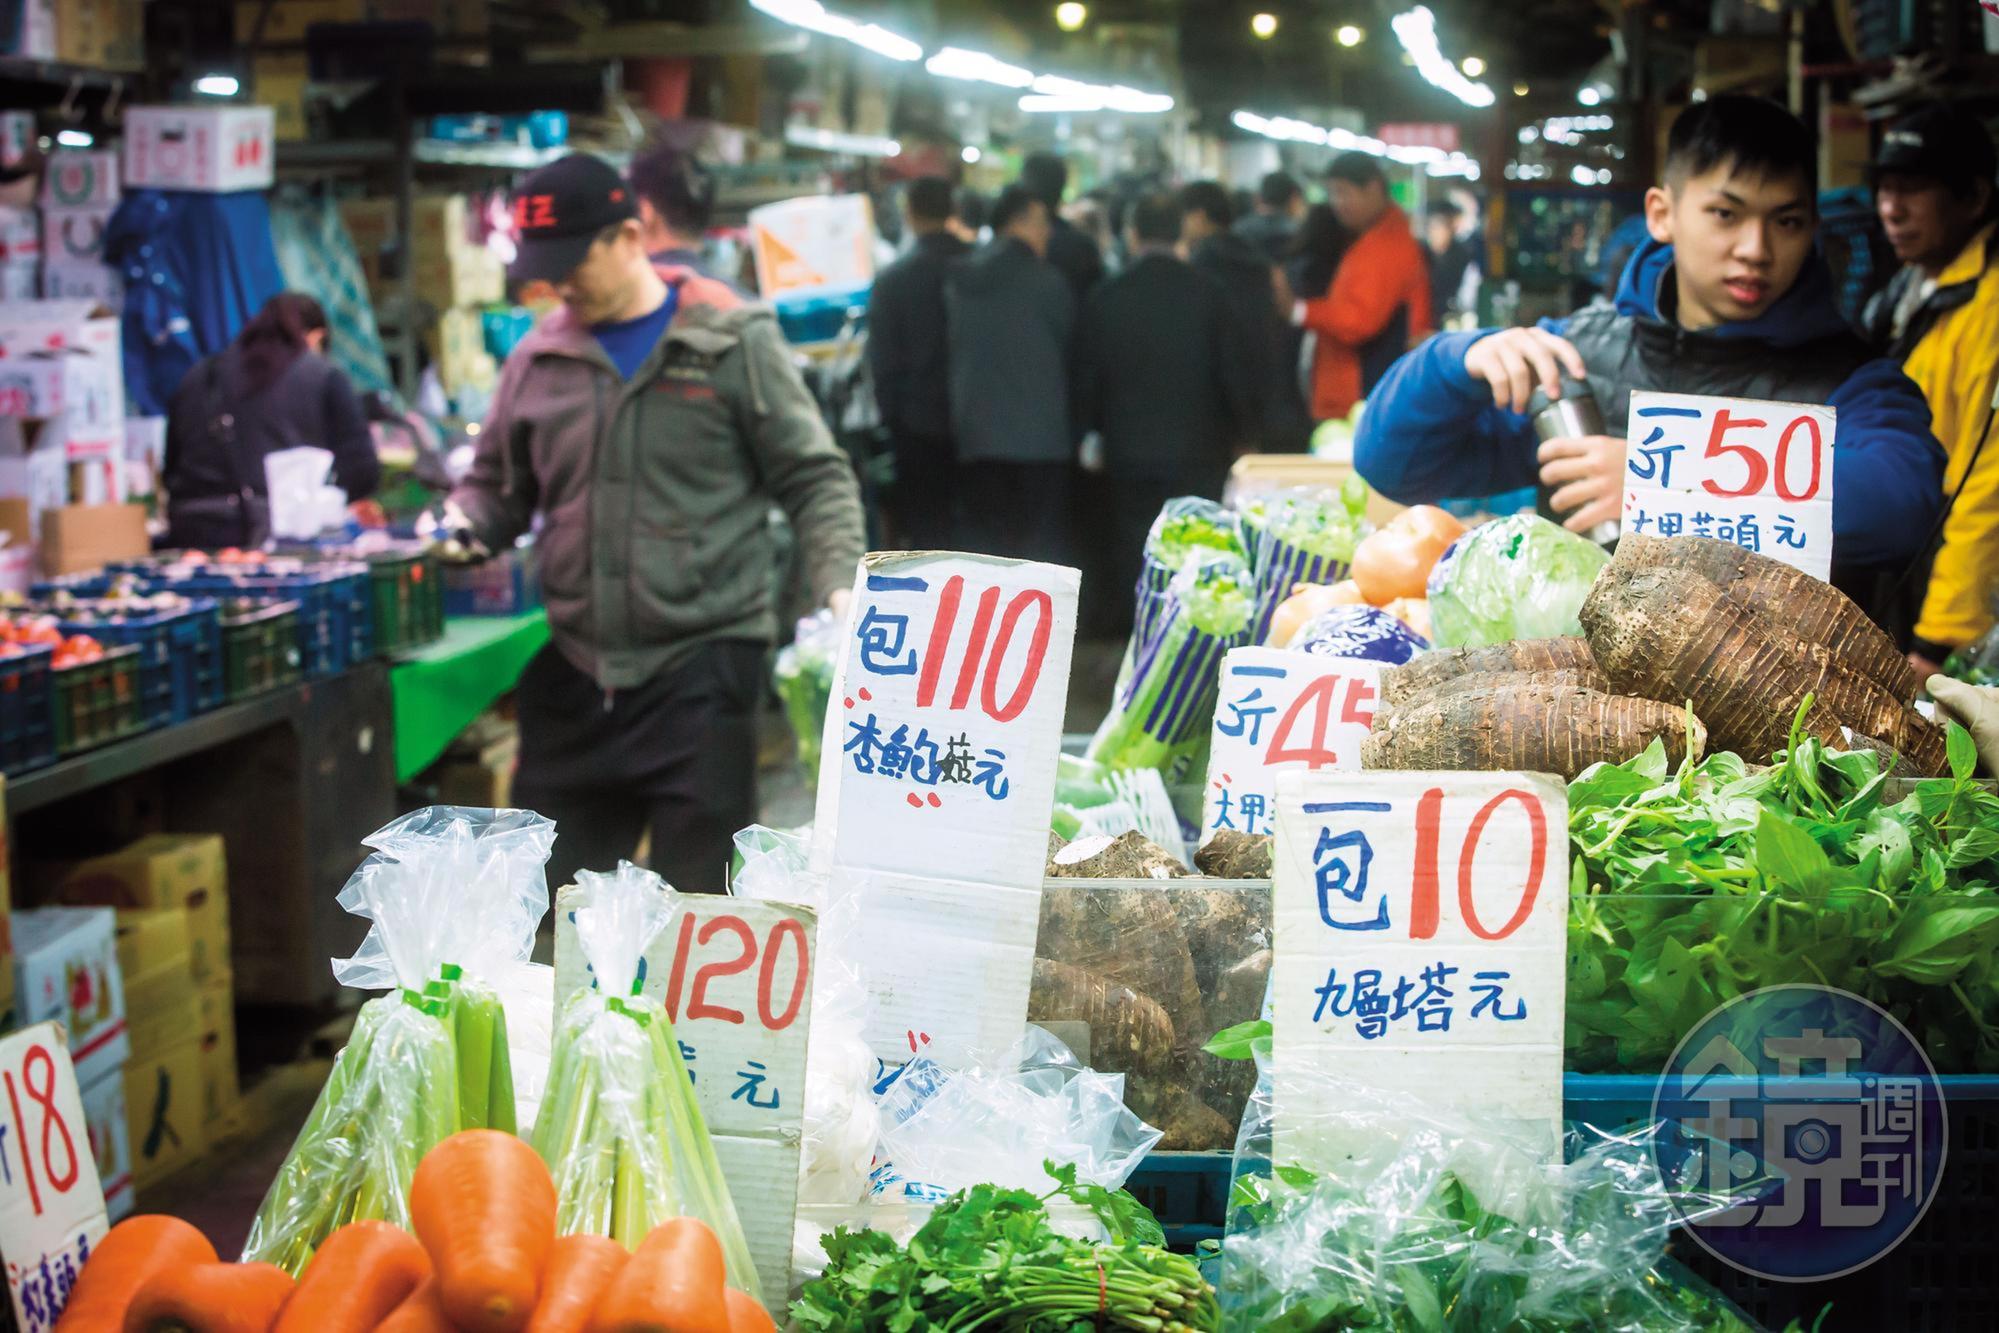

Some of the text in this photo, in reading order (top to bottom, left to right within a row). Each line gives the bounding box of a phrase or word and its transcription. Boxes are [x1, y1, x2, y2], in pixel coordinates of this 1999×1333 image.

[1701, 408, 1822, 503] 50
[856, 574, 930, 676] 一包
[916, 574, 1053, 723] 110
[1302, 801, 1392, 931] 一包
[1408, 787, 1548, 941] 10
[664, 911, 810, 1031] 120
[3, 1044, 79, 1216] 18
[730, 1060, 780, 1110] 元
